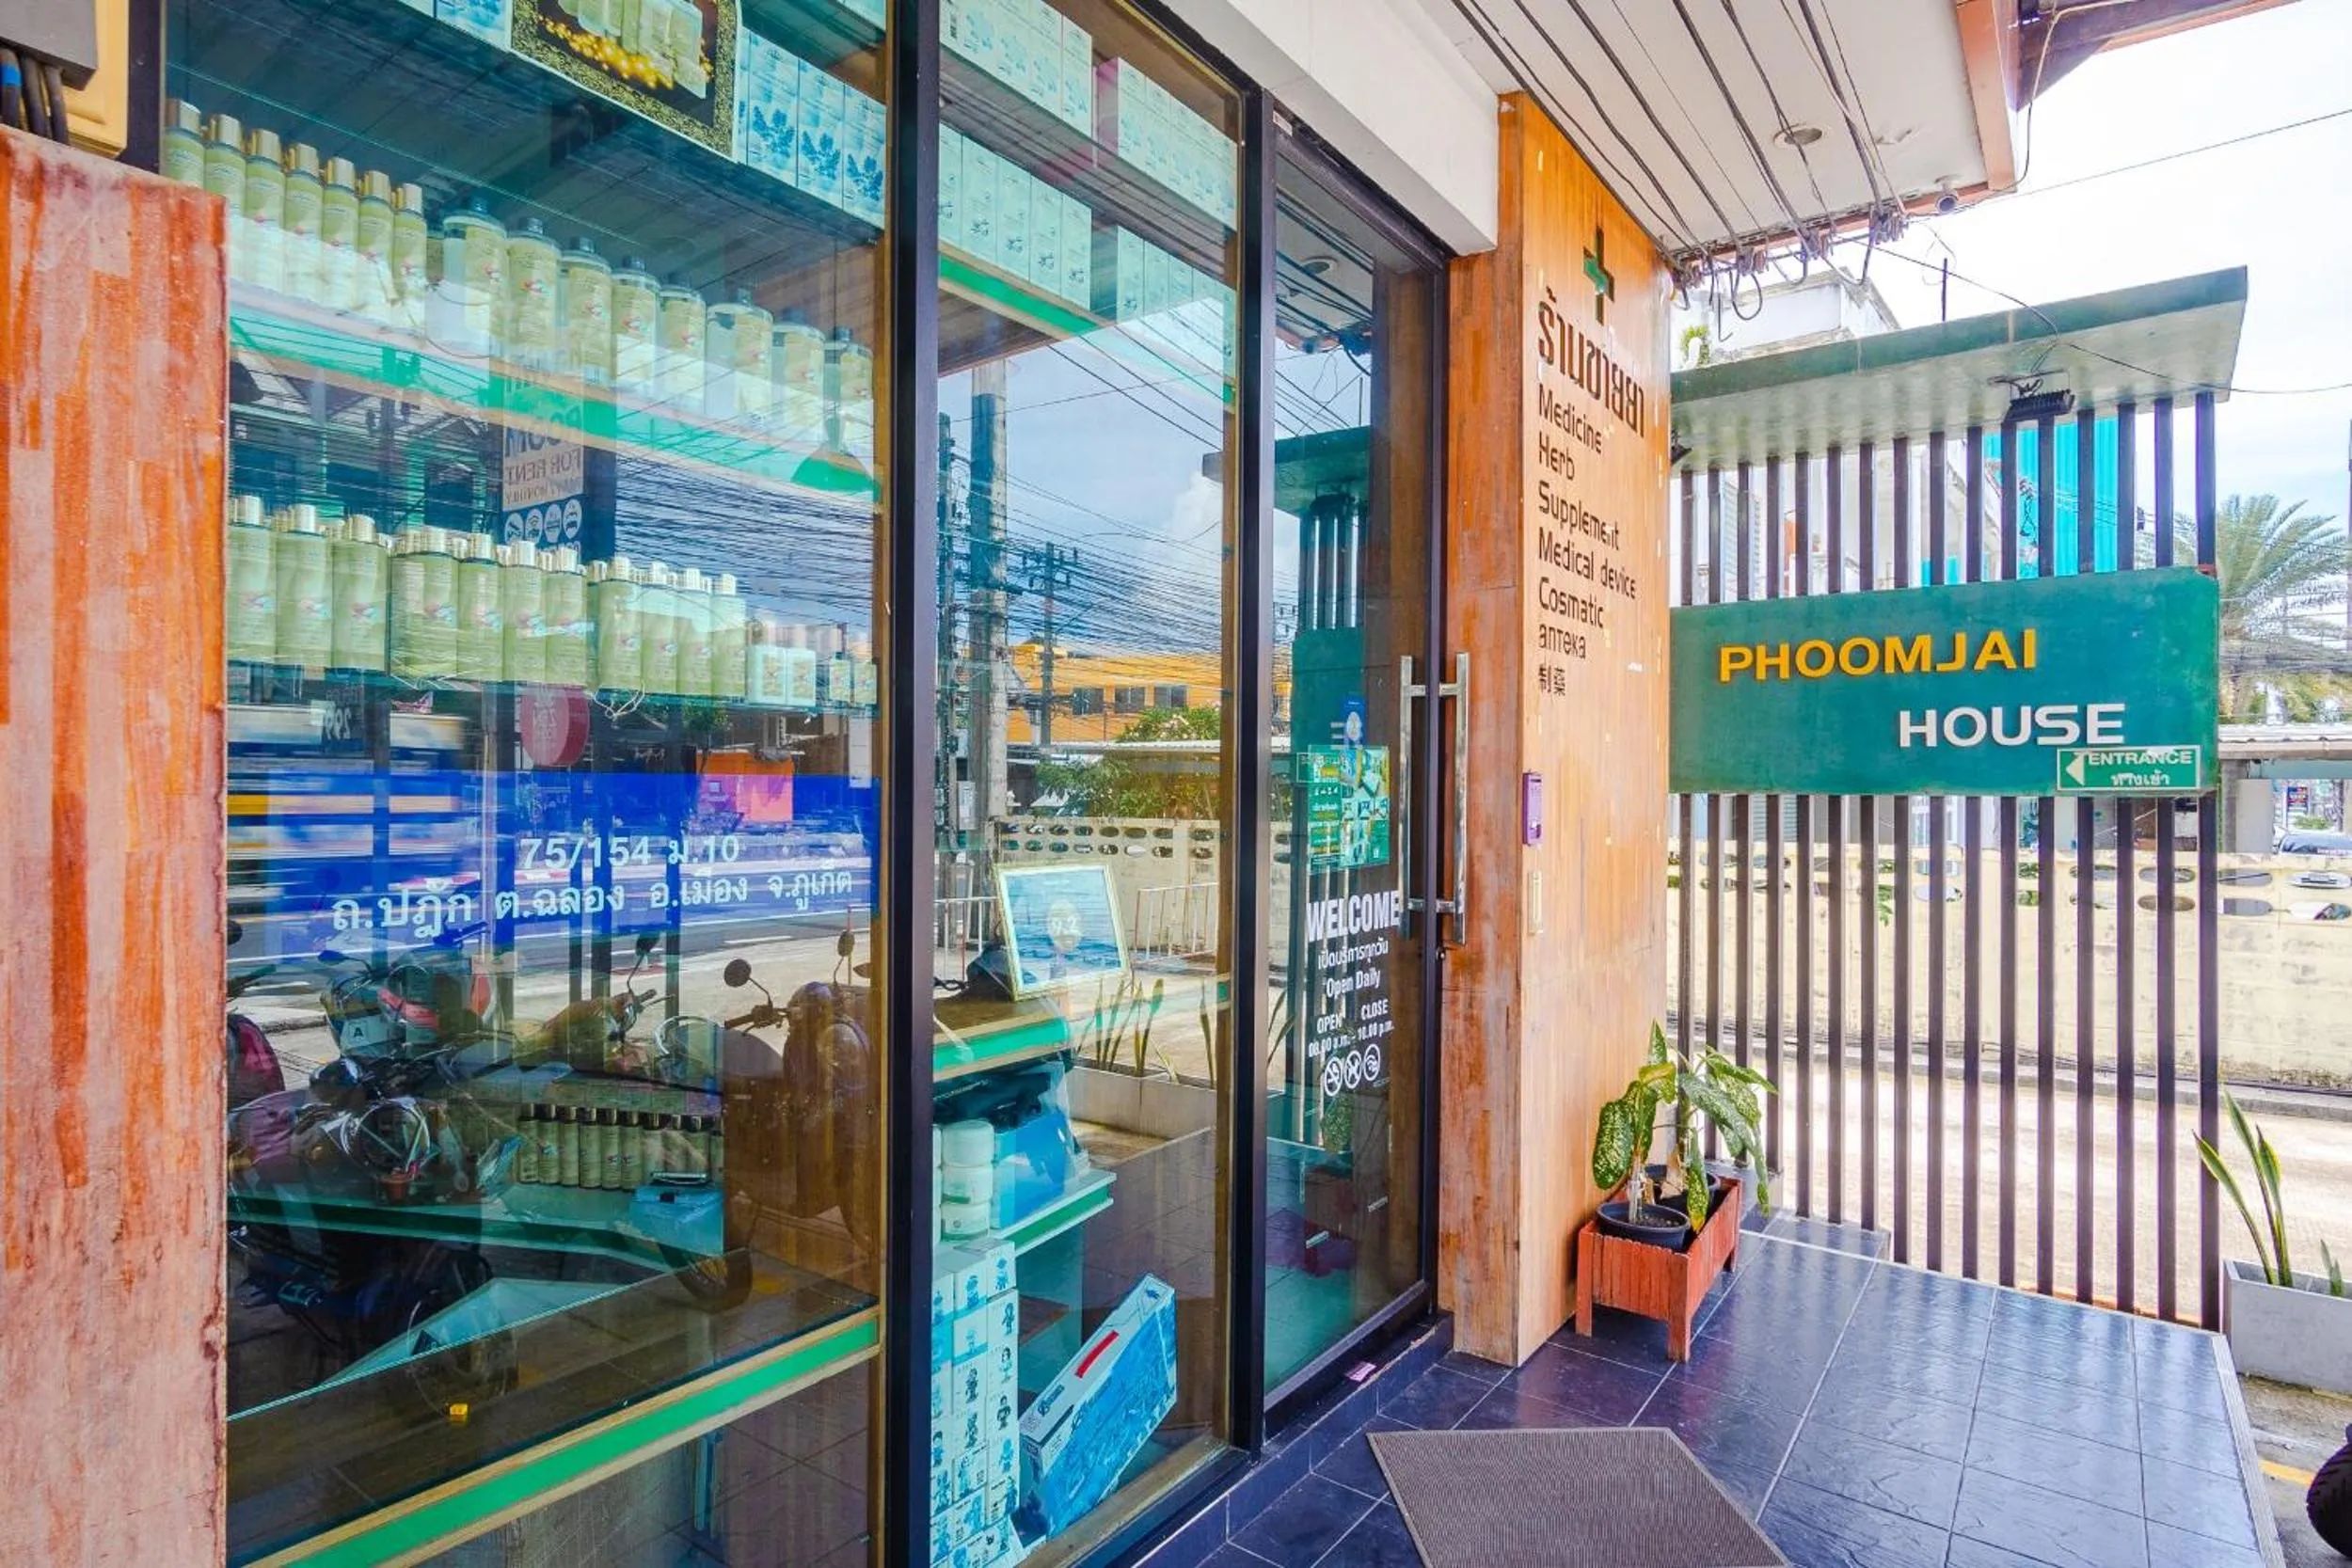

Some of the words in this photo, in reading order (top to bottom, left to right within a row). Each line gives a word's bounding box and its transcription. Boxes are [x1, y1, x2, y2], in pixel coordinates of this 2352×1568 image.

[1538, 286, 1645, 438] ร้านขายยา
[1538, 384, 1602, 454] Medicine
[1538, 432, 1575, 481] Herb
[1538, 527, 1594, 578] Medical
[1600, 561, 1636, 599] device
[1538, 577, 1604, 629] Cosmatic
[1719, 628, 2036, 682] PHOOMJAI
[1899, 704, 2125, 748] HOUSE
[2088, 751, 2193, 767] ENTRANCE
[519, 835, 651, 869] 75/154
[668, 834, 740, 864] ม.10
[495, 885, 625, 920] ต.ฉลอง
[1306, 890, 1402, 942] WELCOME
[1326, 976, 1353, 1000] Open
[1356, 967, 1380, 990] Daily
[1317, 1013, 1343, 1034] OPEN
[1361, 999, 1389, 1021] CLOSE
